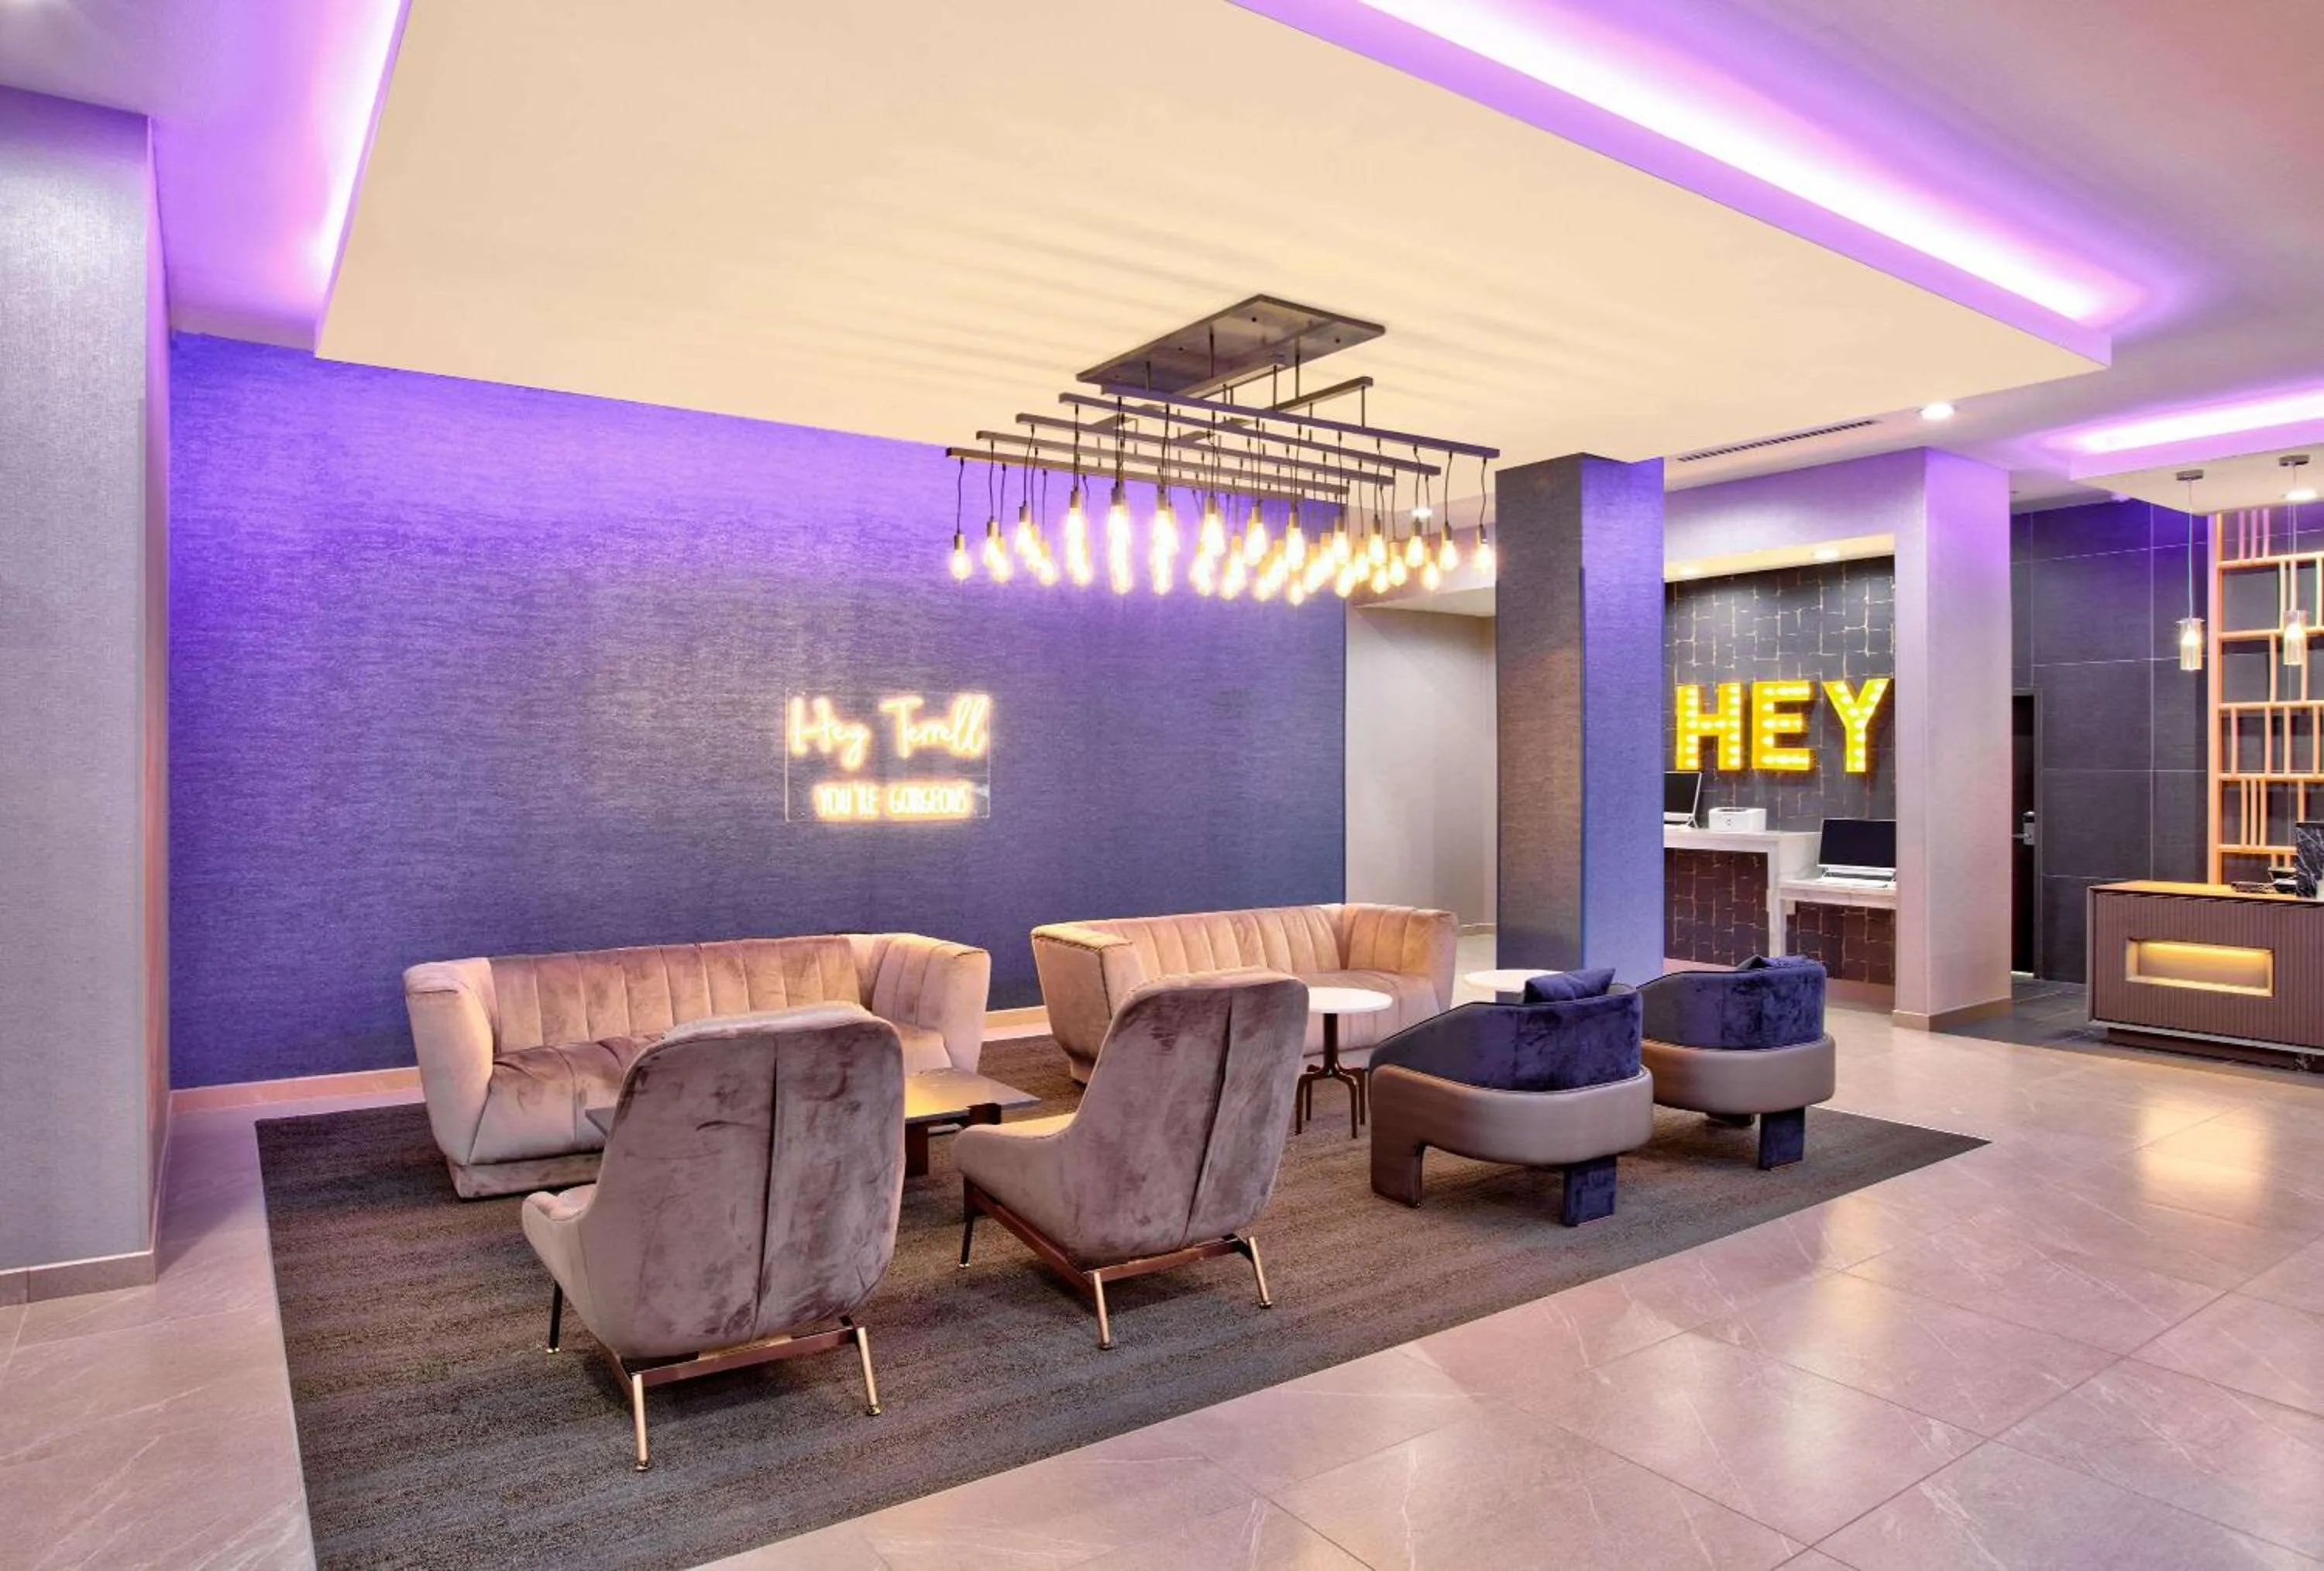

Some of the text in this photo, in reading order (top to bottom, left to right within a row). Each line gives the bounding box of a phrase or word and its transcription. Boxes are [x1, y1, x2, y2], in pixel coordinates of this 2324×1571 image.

[789, 693, 990, 768] Hey Terrell
[1676, 678, 1892, 772] HEY
